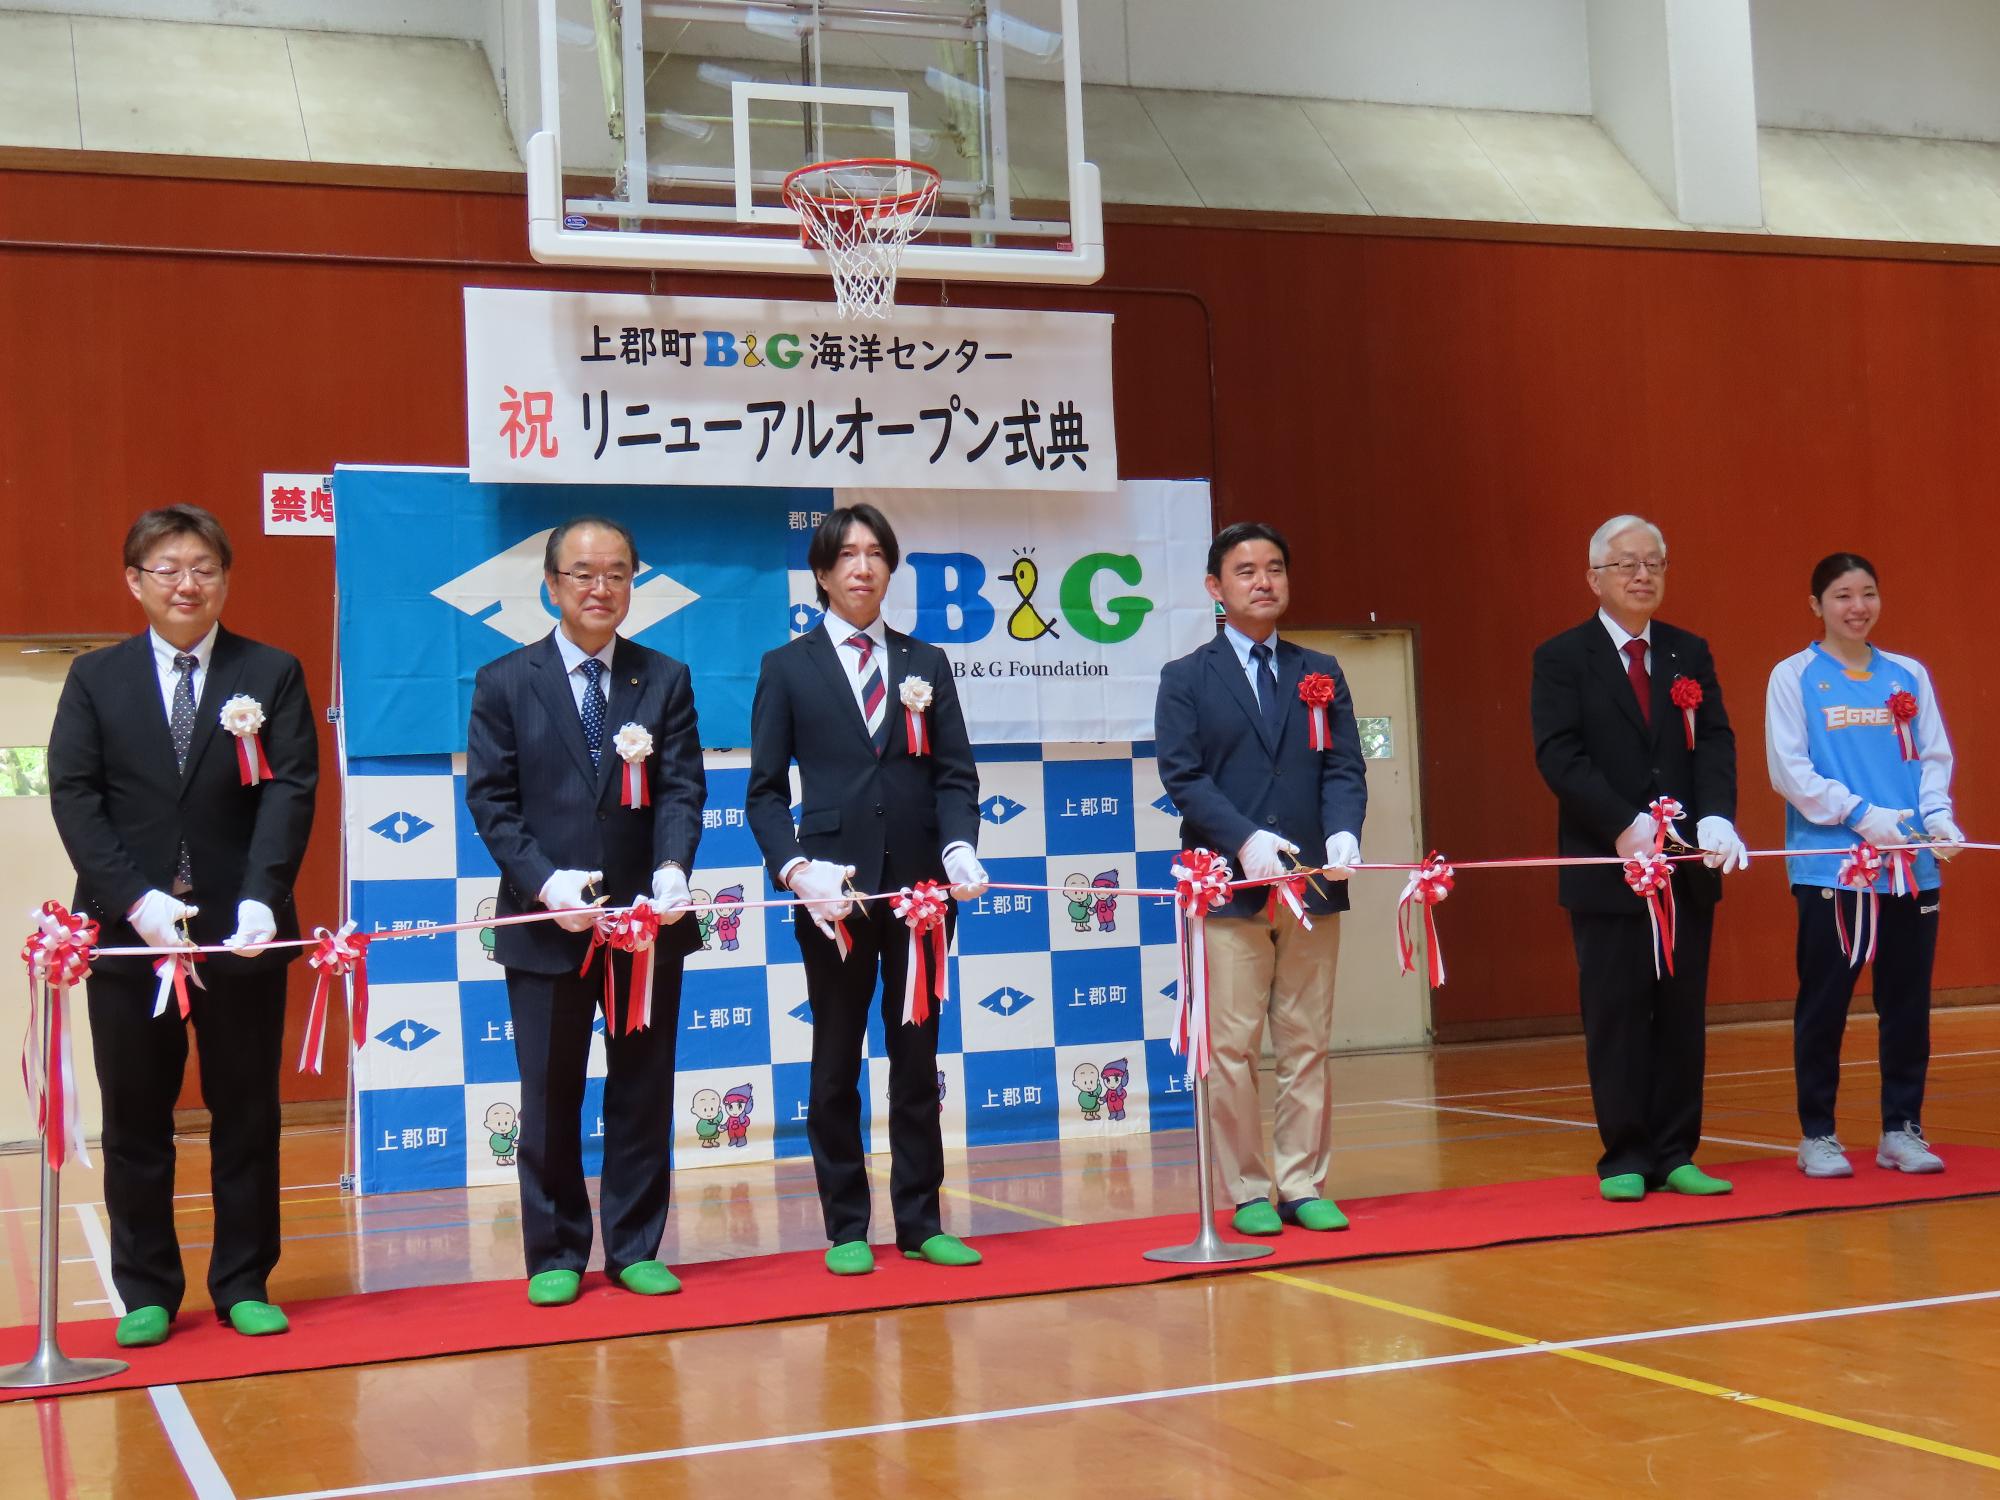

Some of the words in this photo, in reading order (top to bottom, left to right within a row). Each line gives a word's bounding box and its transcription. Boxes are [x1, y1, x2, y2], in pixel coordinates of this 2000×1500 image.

[498, 385, 560, 461] 祝
[581, 389, 1090, 472] リニューアルオープン式典
[1009, 660, 1109, 677] Foundation
[1822, 704, 1898, 731] EGRE
[1060, 797, 1119, 817] 上郡町
[972, 894, 1033, 916] 上郡町
[1068, 985, 1127, 1008] 上郡町
[687, 1006, 752, 1030] 上郡町
[981, 1086, 1042, 1108] 上郡町
[376, 1126, 448, 1152] 上郡町
